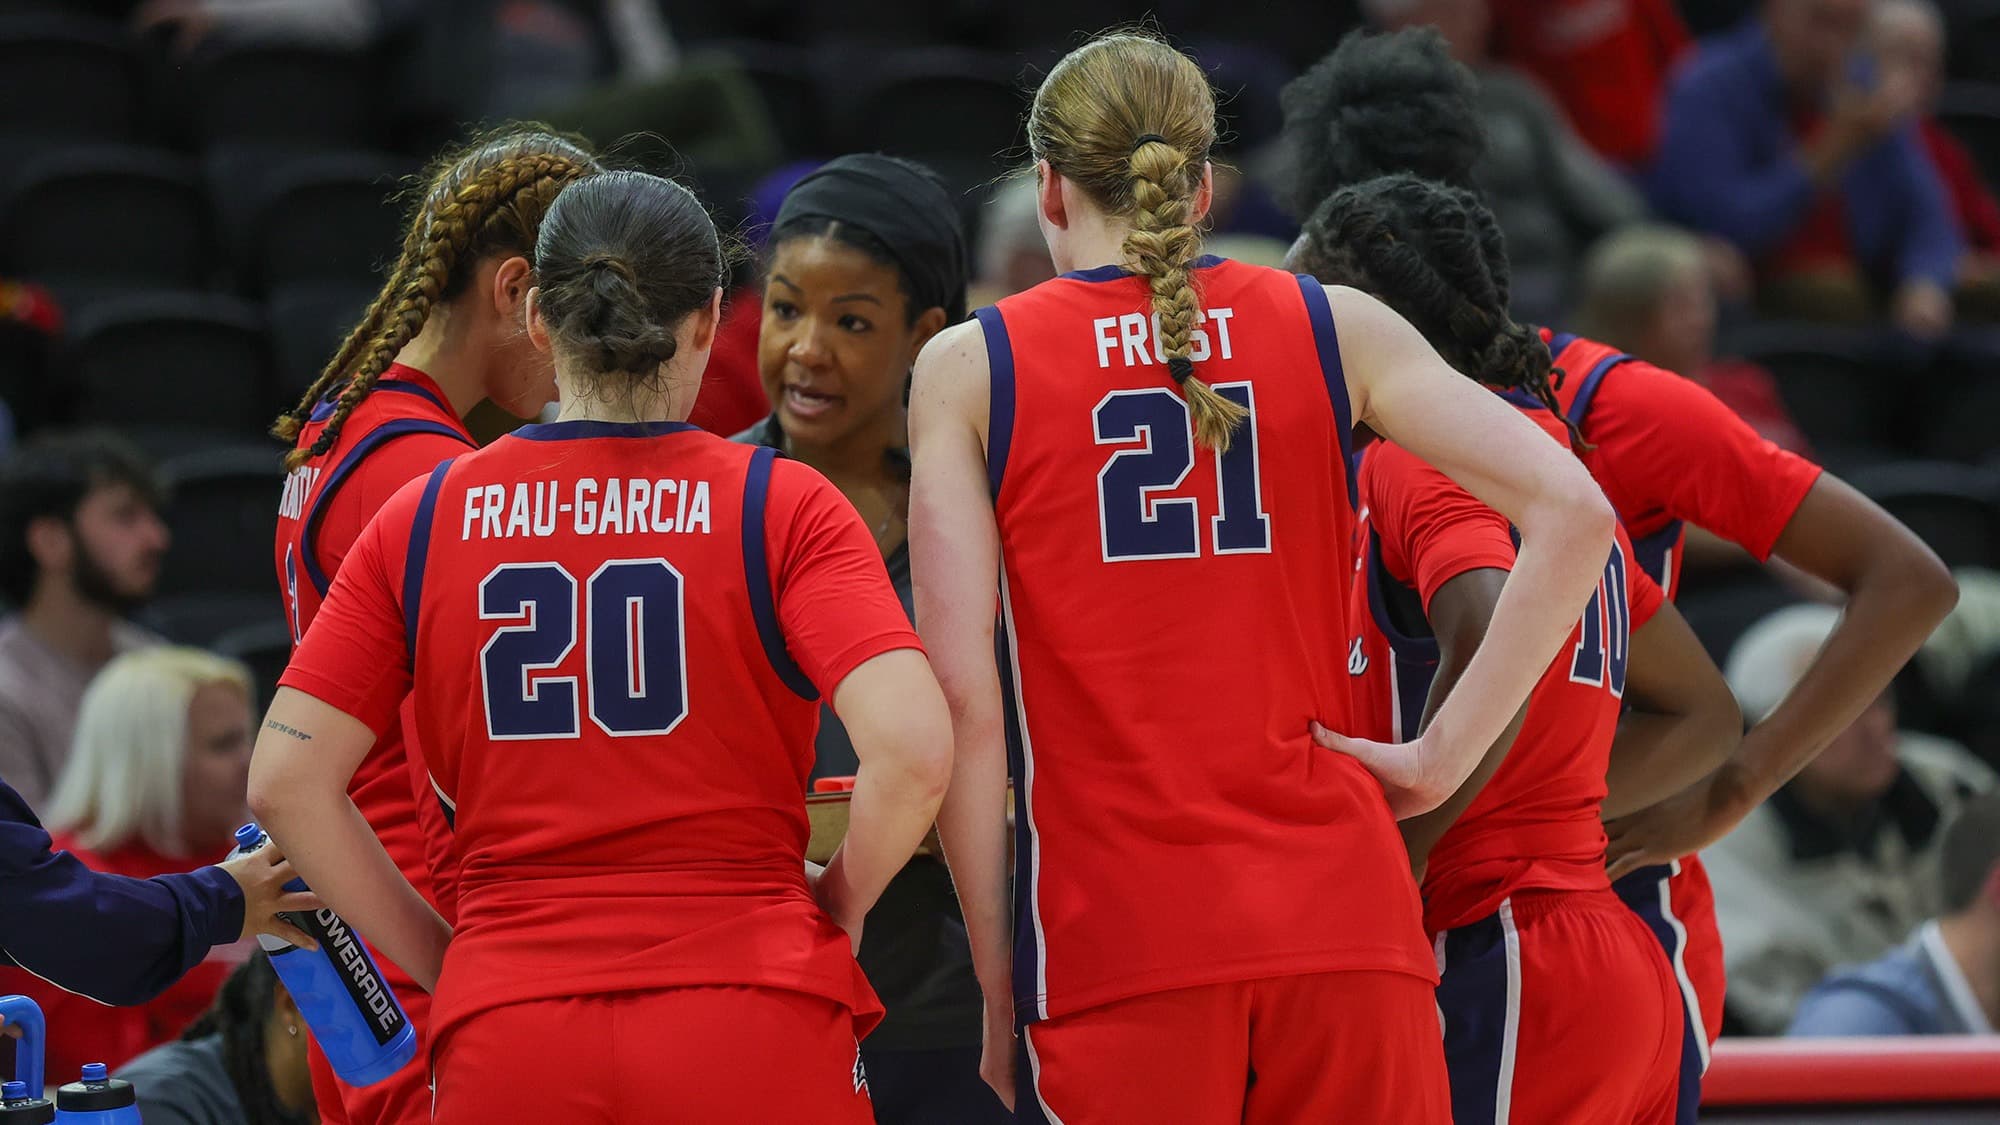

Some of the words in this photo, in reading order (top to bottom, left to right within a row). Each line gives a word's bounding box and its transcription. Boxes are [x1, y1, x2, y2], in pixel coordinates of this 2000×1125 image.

[461, 477, 711, 541] FRAU-GARCIA
[1091, 380, 1272, 563] 21
[478, 557, 689, 741] 20
[315, 906, 399, 1034] OWERADE
